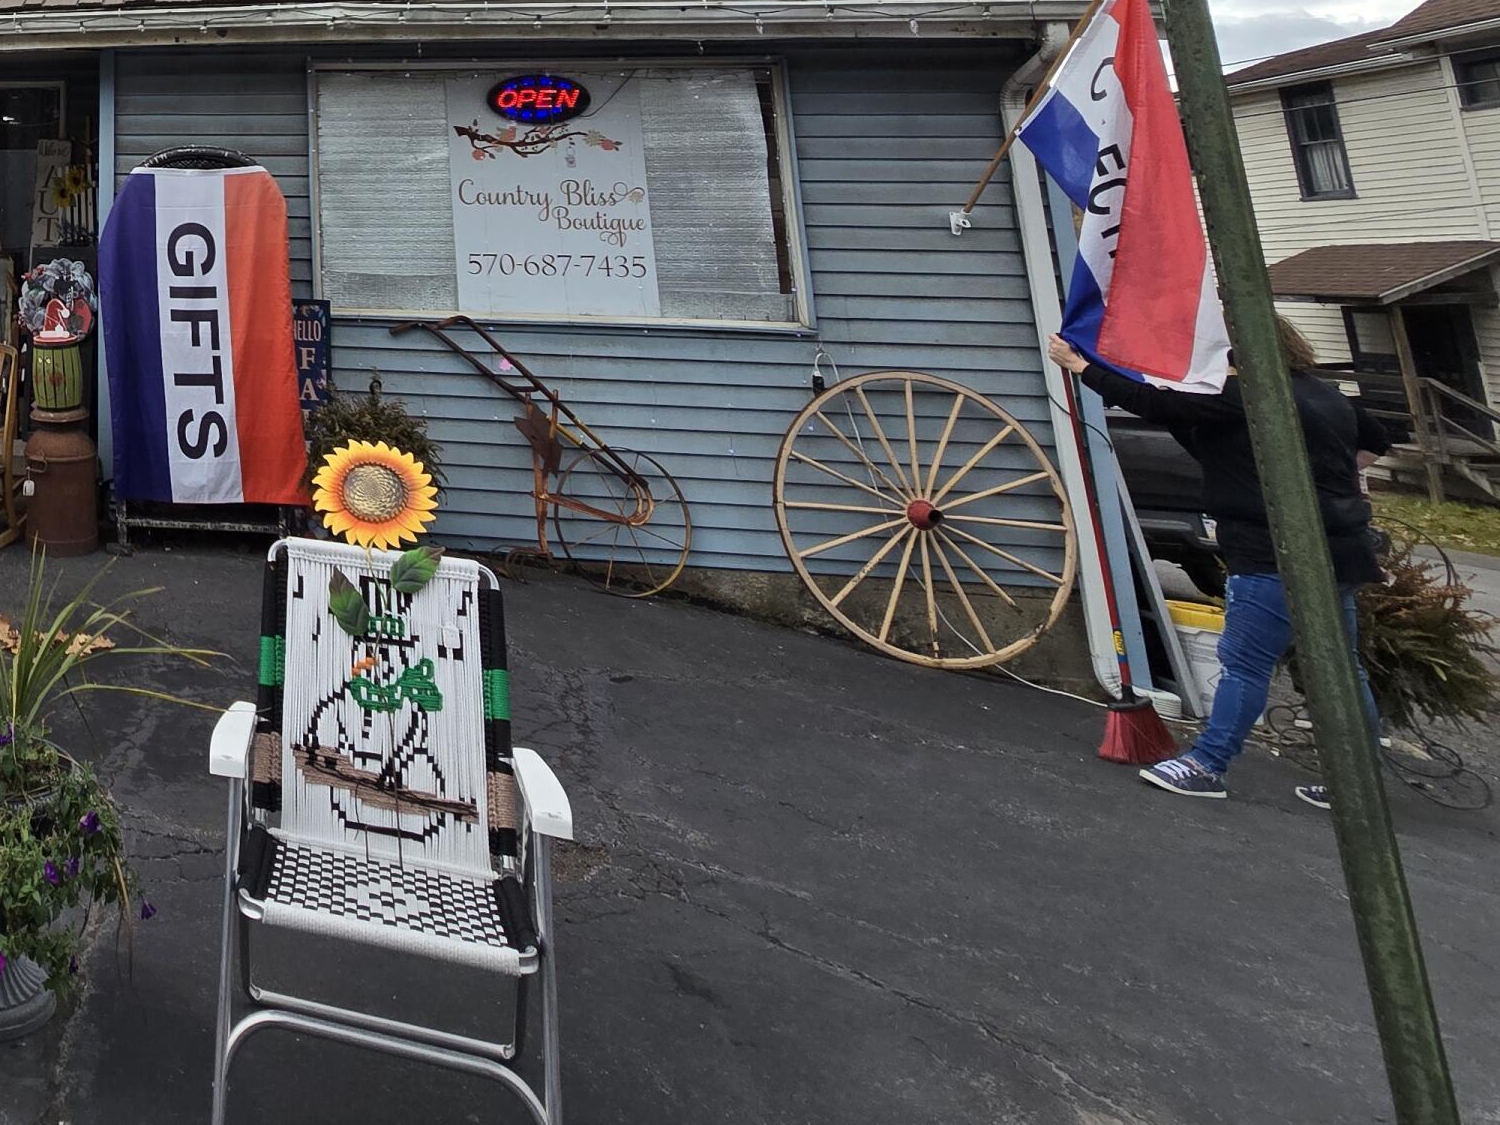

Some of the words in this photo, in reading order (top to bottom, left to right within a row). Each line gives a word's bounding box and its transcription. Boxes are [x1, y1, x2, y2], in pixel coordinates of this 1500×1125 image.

[497, 89, 580, 108] OPEN
[458, 179, 552, 222] Country
[560, 180, 627, 206] Bliss
[552, 206, 647, 248] Boutique
[468, 253, 647, 278] 570-687-7435
[167, 222, 228, 460] GIFTS
